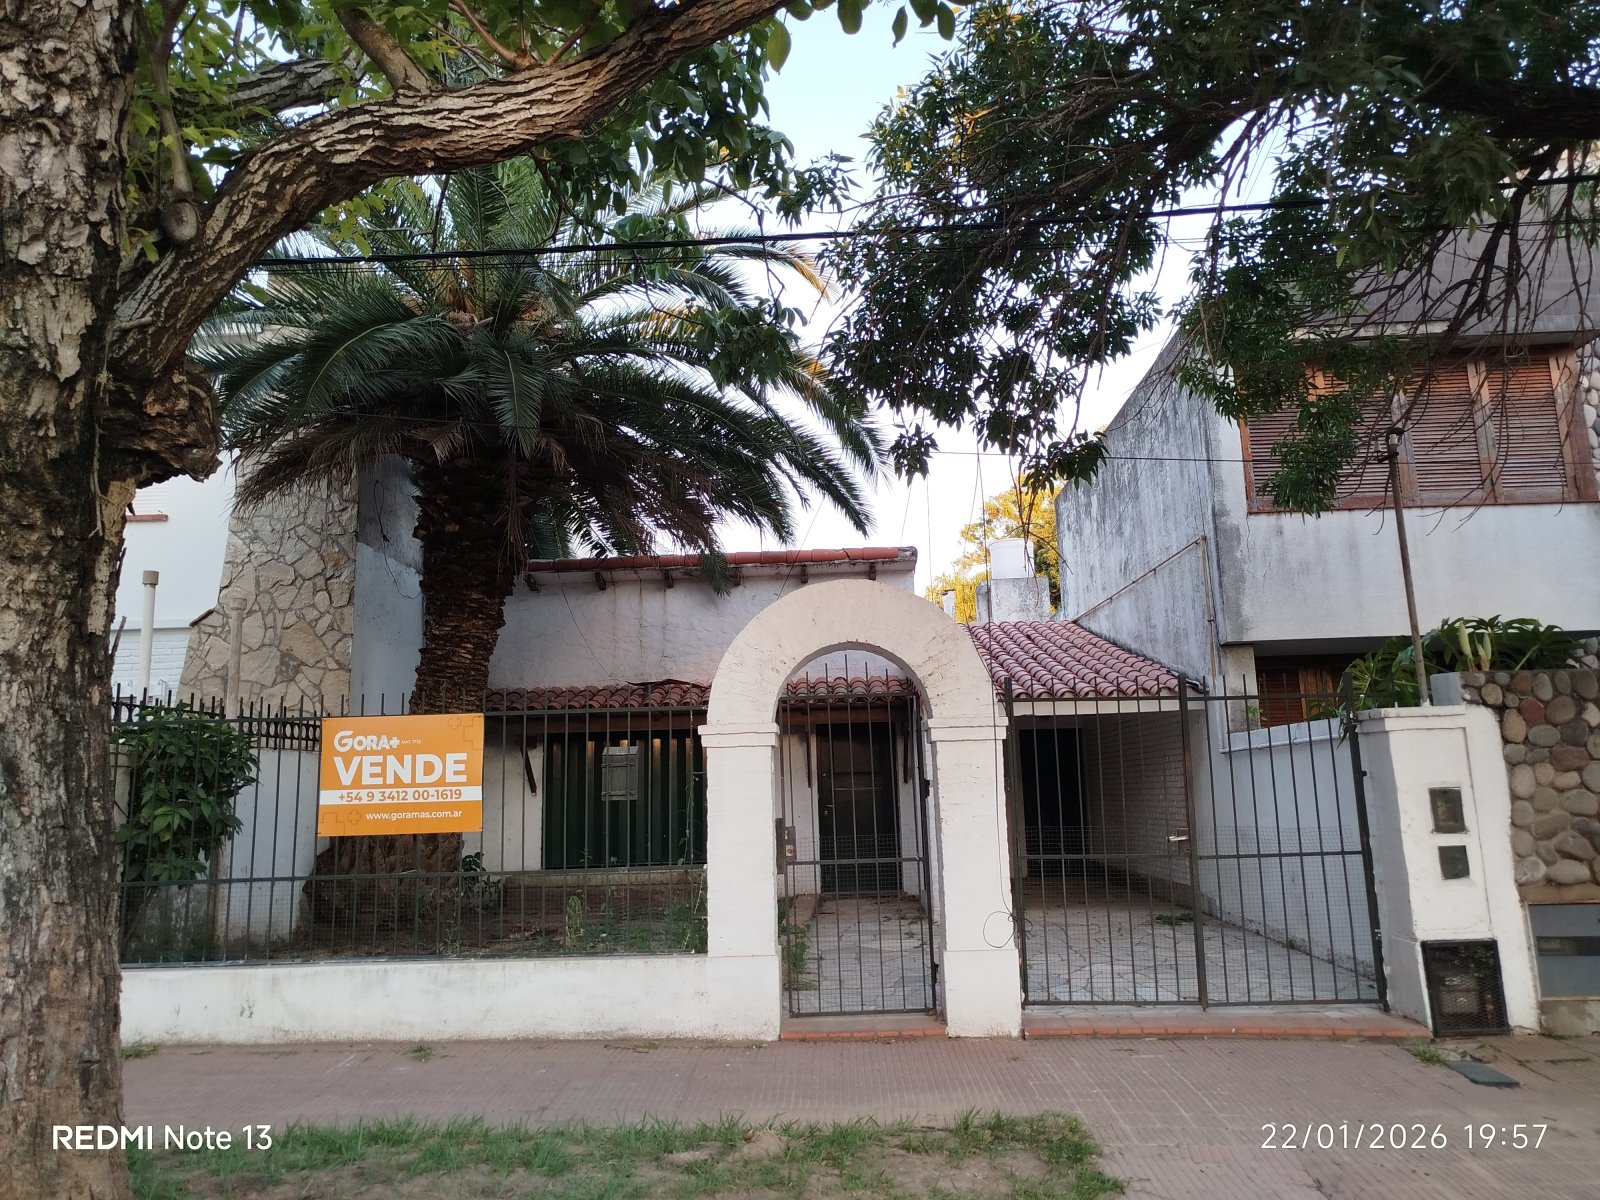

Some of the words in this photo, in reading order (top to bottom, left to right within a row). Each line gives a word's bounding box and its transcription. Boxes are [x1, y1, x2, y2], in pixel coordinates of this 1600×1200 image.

[333, 753, 468, 786] VENDE
[338, 792, 363, 802] +54
[366, 791, 375, 802] 9
[378, 790, 409, 802] 3412
[412, 789, 463, 801] 00-1619
[365, 810, 463, 821] www.goramas.com.ar
